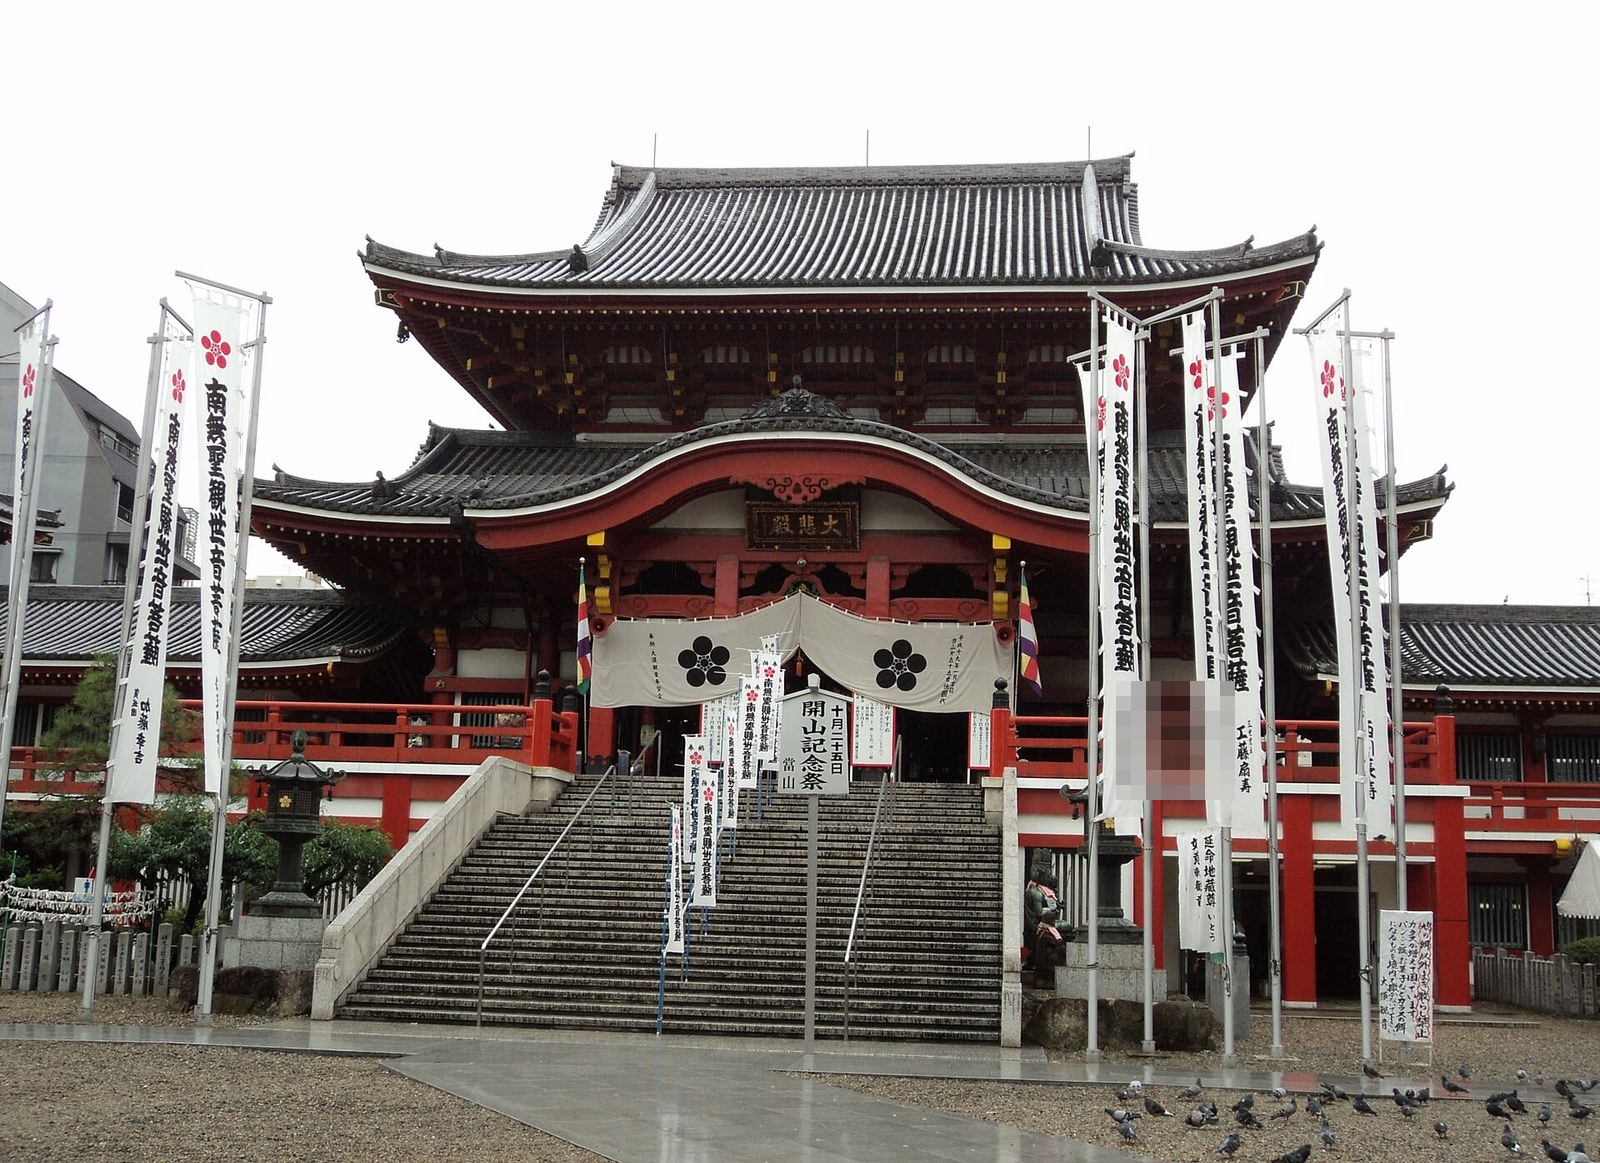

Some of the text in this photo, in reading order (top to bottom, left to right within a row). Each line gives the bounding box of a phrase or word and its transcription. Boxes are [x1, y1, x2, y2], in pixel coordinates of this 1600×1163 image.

[204, 377, 229, 655] 南無聖観世音菩薩
[769, 514, 842, 537] 大悲殿
[782, 758, 796, 790] 當山
[800, 701, 827, 790] 開山記念祭
[831, 705, 844, 775] 十月二十五日
